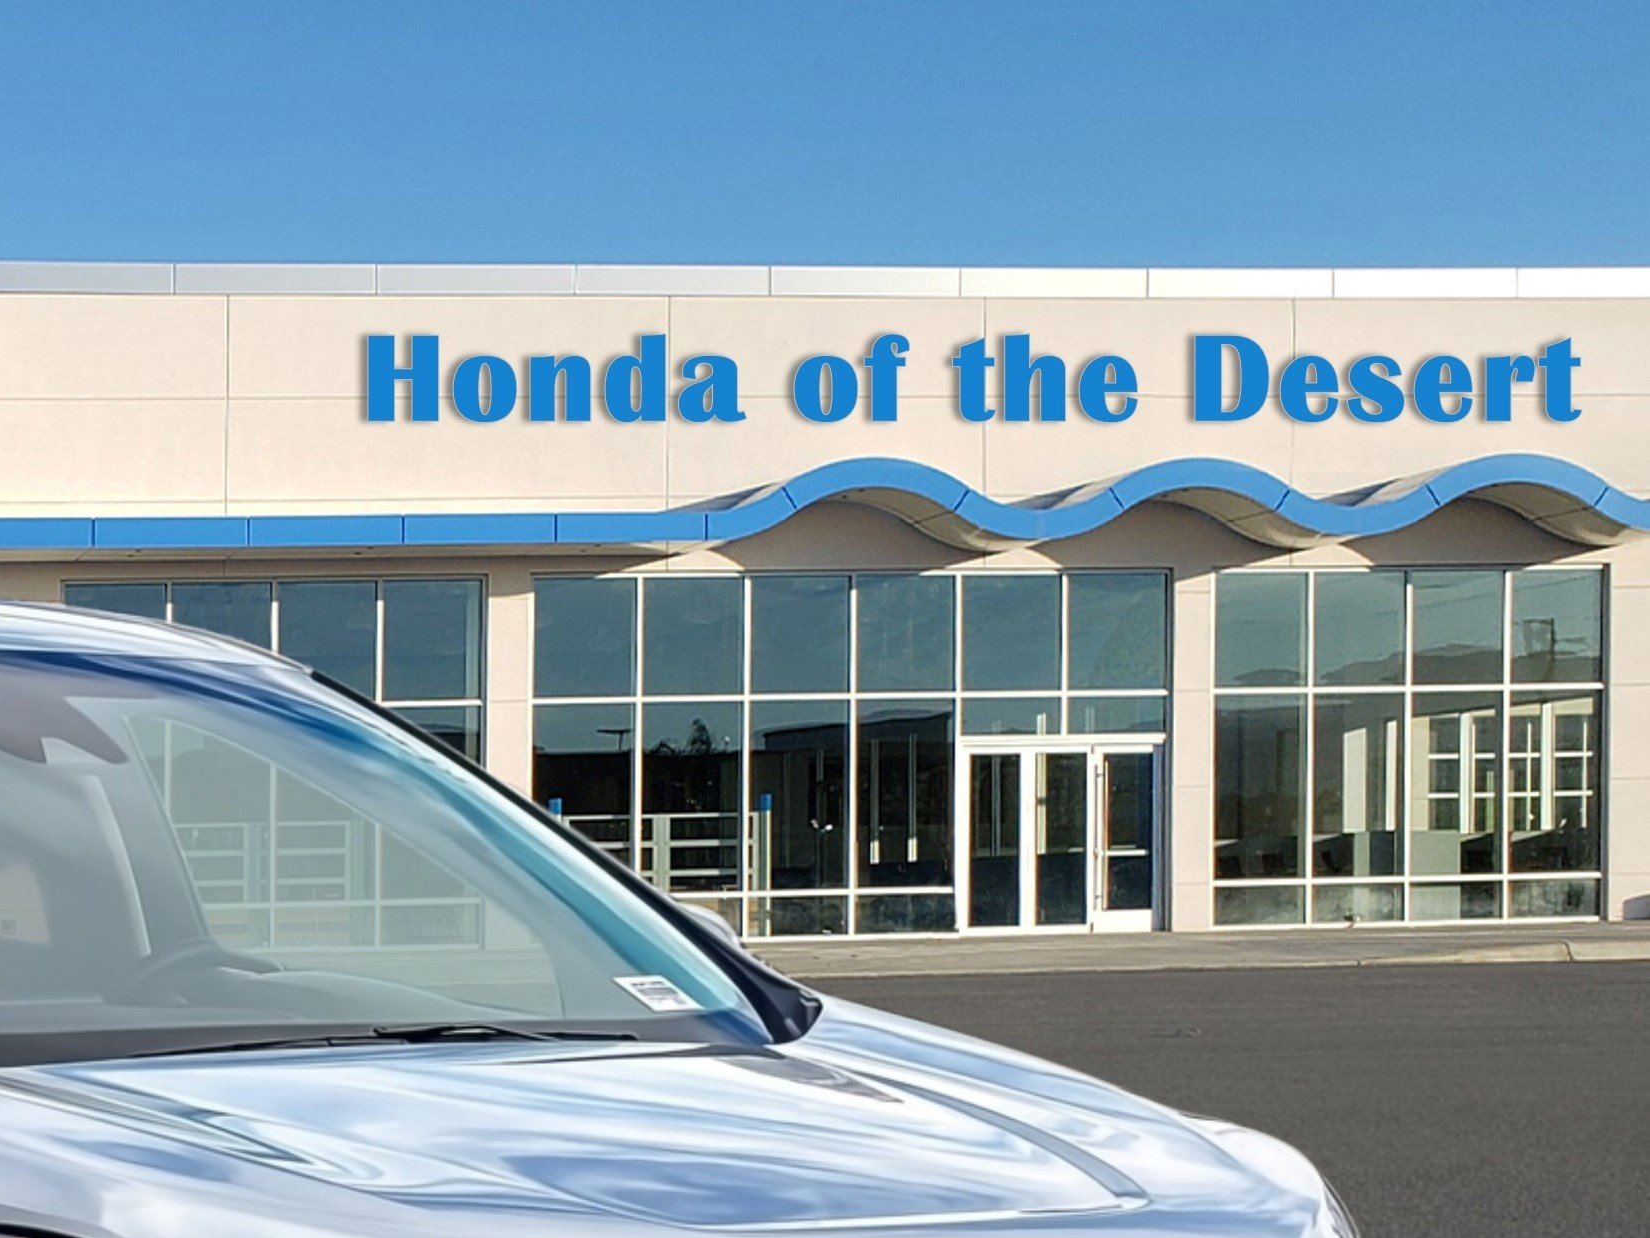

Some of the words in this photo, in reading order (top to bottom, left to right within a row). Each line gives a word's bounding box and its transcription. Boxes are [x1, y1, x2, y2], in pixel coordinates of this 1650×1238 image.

[366, 333, 747, 424] Honda
[793, 333, 910, 424] of
[952, 333, 1139, 424] the
[1193, 333, 1583, 424] Desert
